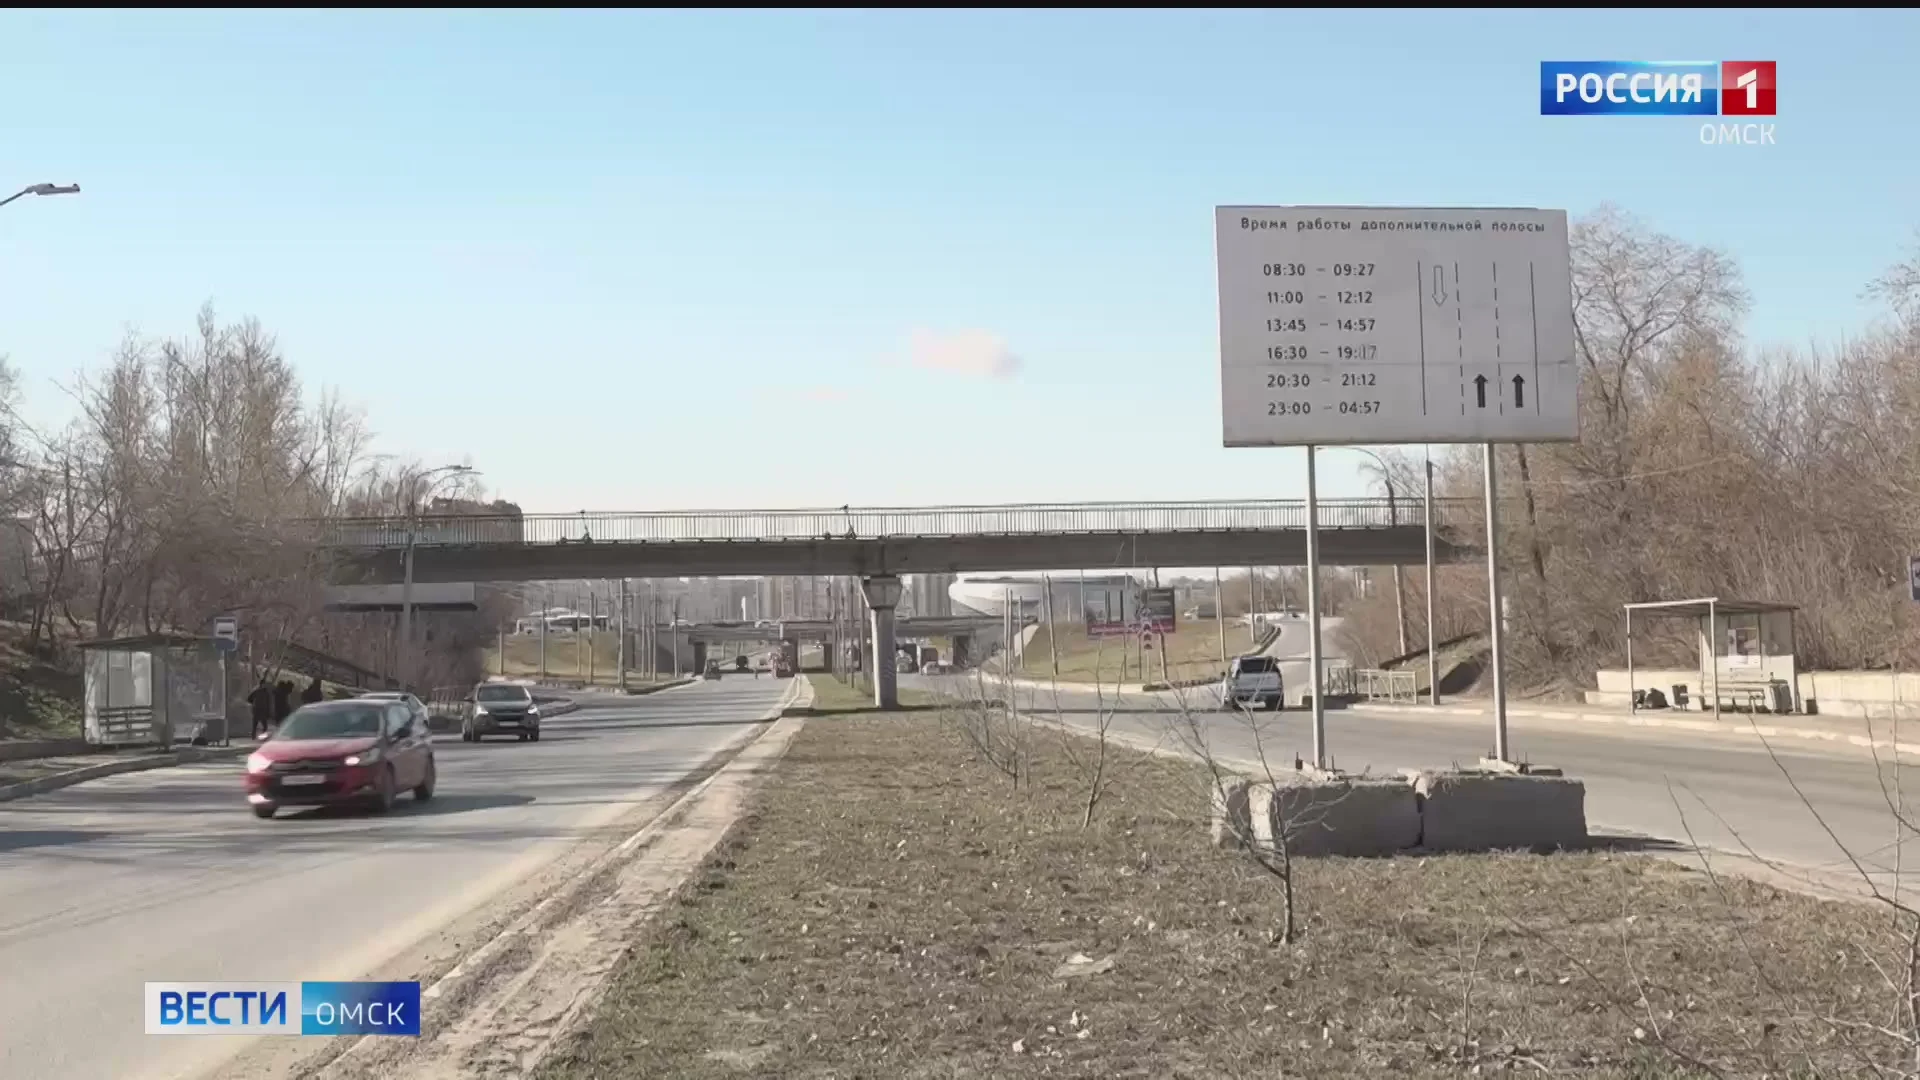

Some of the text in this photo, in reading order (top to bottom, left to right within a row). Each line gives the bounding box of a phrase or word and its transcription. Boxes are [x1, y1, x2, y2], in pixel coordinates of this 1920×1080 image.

[1240, 216, 1545, 233] Время работы дополнительной полосы
[1263, 263, 1306, 277] 08:30
[1333, 263, 1376, 277] 09:27
[1267, 290, 1304, 304] 11:00
[1337, 290, 1373, 304] 12:12
[1266, 318, 1307, 332] 13:45
[1336, 317, 1376, 332] 14:57
[1267, 345, 1308, 360] 16:30
[1267, 373, 1311, 388] 20:30
[1341, 373, 1377, 387] 21:12
[1267, 401, 1312, 416] 23:00
[1339, 400, 1381, 415] 04:57
